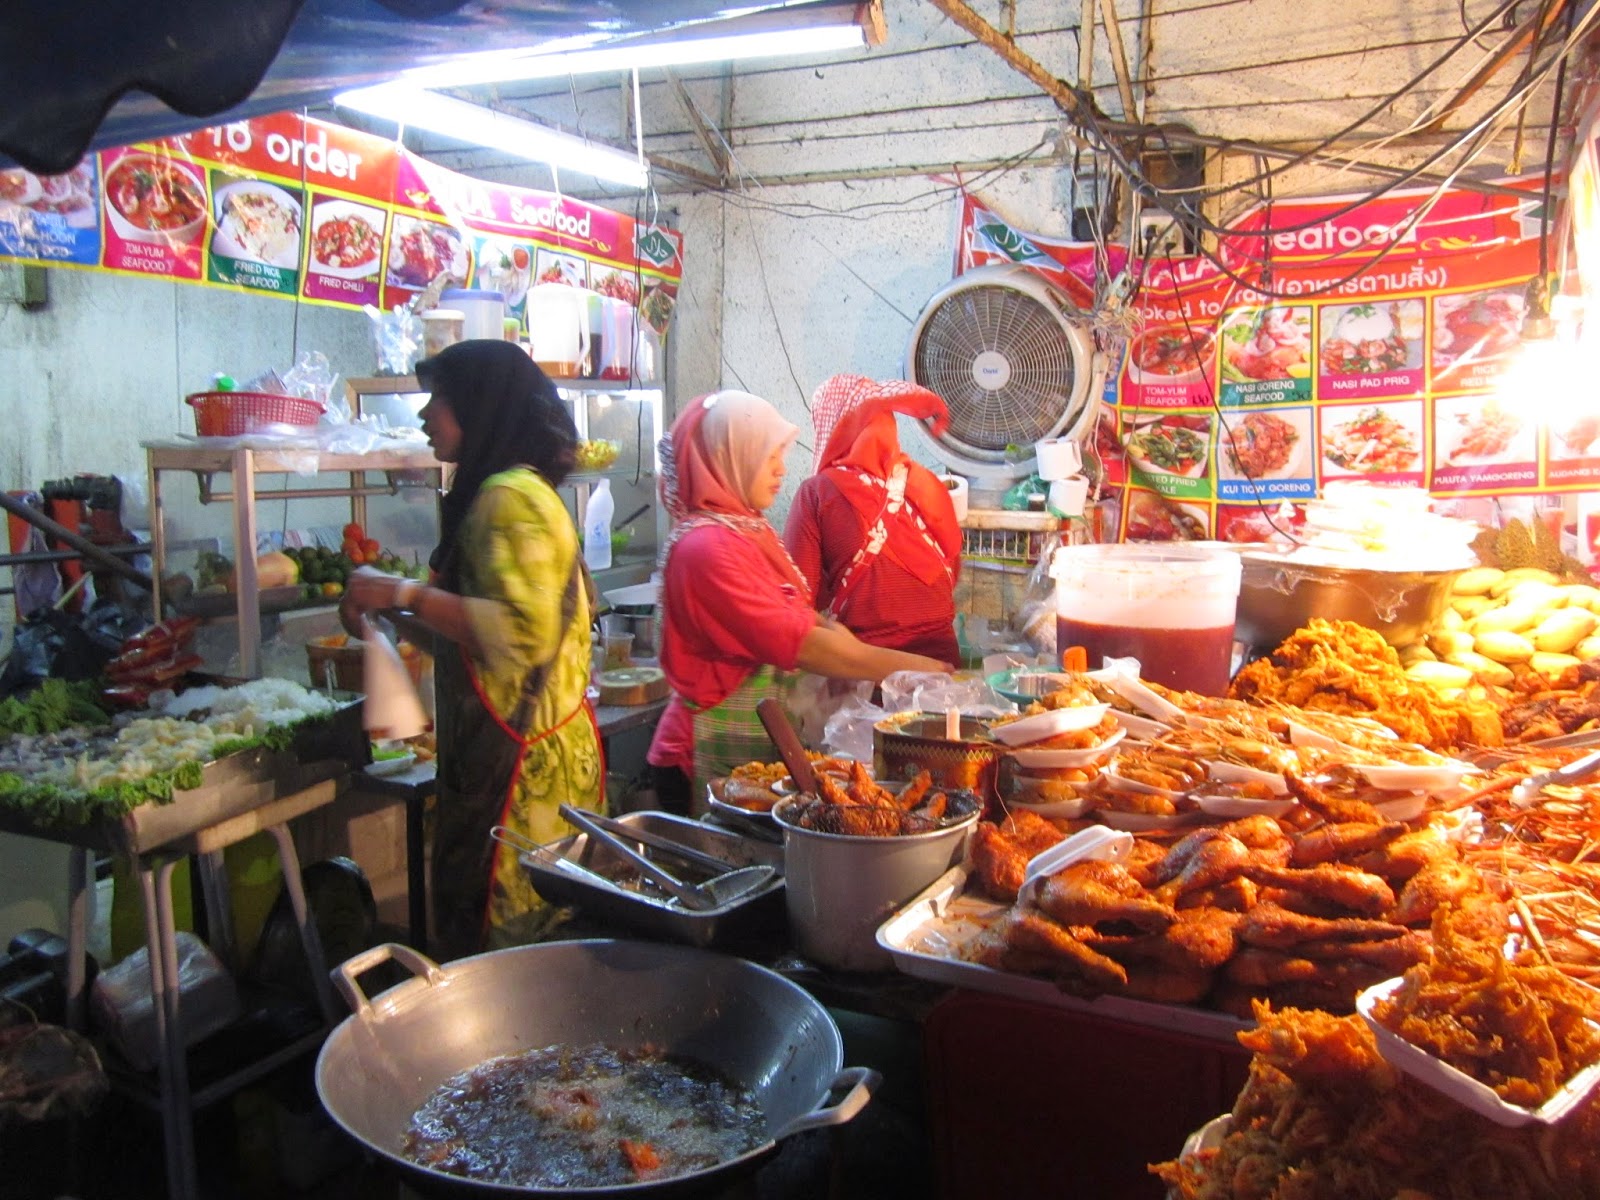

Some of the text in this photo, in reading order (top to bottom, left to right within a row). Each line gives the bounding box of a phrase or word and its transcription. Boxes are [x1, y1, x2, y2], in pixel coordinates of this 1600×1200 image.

[266, 130, 362, 181] order
[510, 195, 591, 239] Seafood
[125, 242, 164, 259] TOM-YUM
[122, 256, 165, 272] SEAFOOD
[234, 259, 262, 276] FRIED
[235, 272, 280, 290] SEAFOOD
[319, 275, 342, 288] FRIED
[1199, 299, 1221, 317] to
[1235, 380, 1295, 393] NASI GORENG
[1332, 375, 1410, 390] NASI PAD PRIG
[1146, 386, 1187, 395] TOM-YUM
[1244, 391, 1285, 404] SEAFOOD
[1145, 397, 1187, 406] SEAFOOD
[1170, 476, 1197, 487] FRIED
[1222, 484, 1239, 495] KUI
[1268, 482, 1311, 493] GORENG
